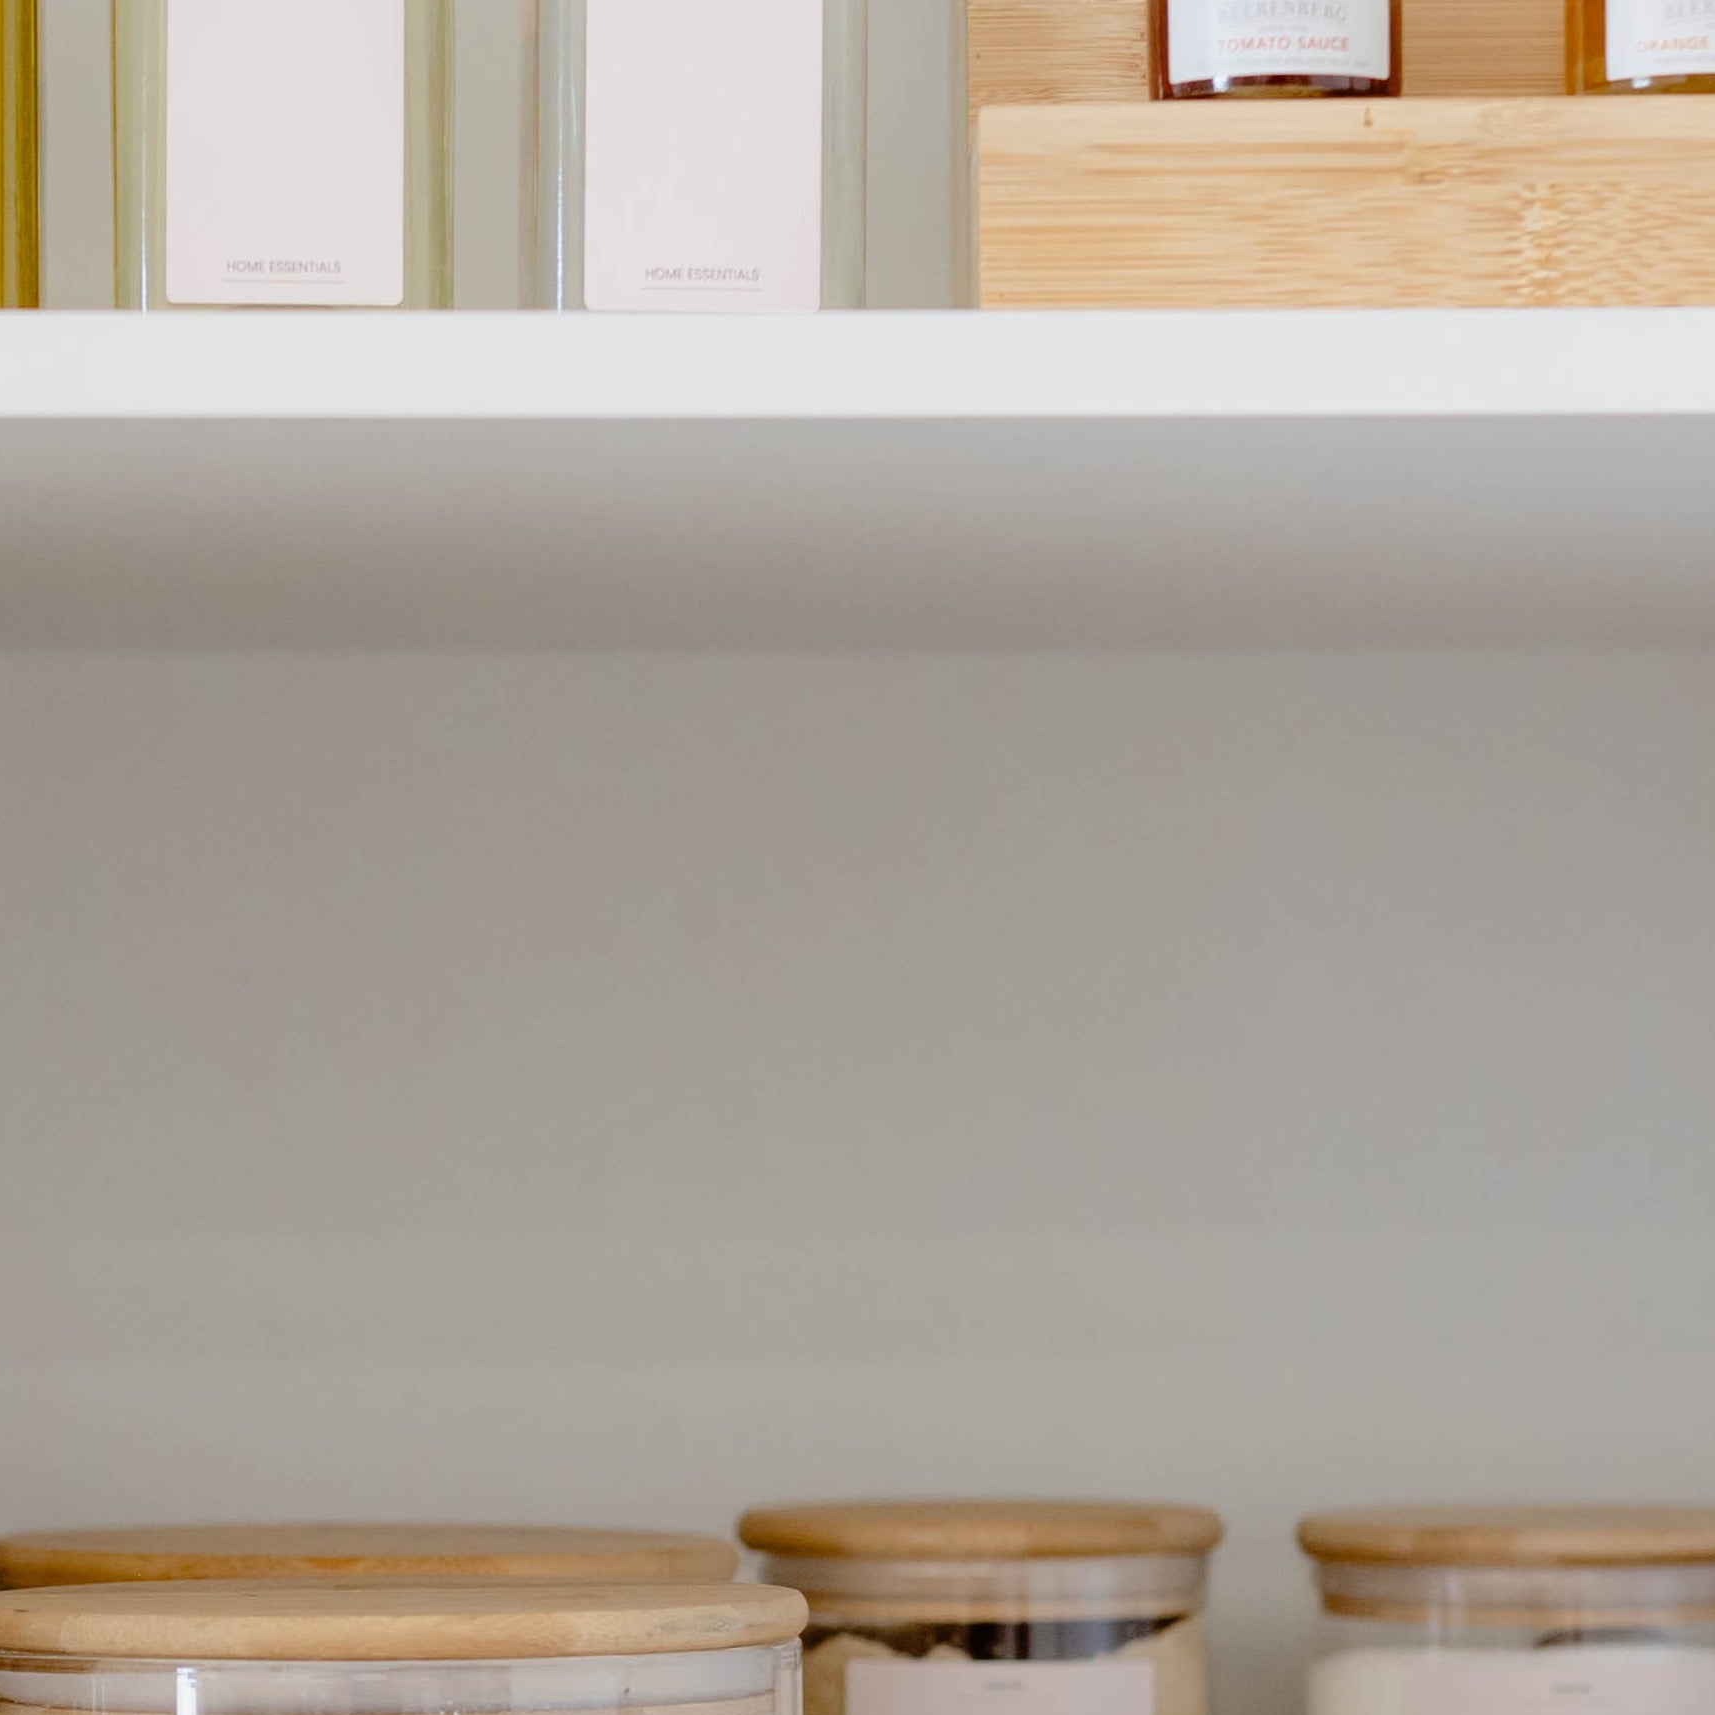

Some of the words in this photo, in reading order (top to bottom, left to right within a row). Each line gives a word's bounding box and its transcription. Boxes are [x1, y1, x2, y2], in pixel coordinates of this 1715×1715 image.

[1217, 36, 1291, 53] TOMATO
[1297, 36, 1350, 51] SAUCE
[226, 260, 265, 273] HOME
[268, 260, 342, 275] ESSENTIALS
[645, 267, 682, 281] HOME
[687, 267, 760, 282] ESSENTIALS
